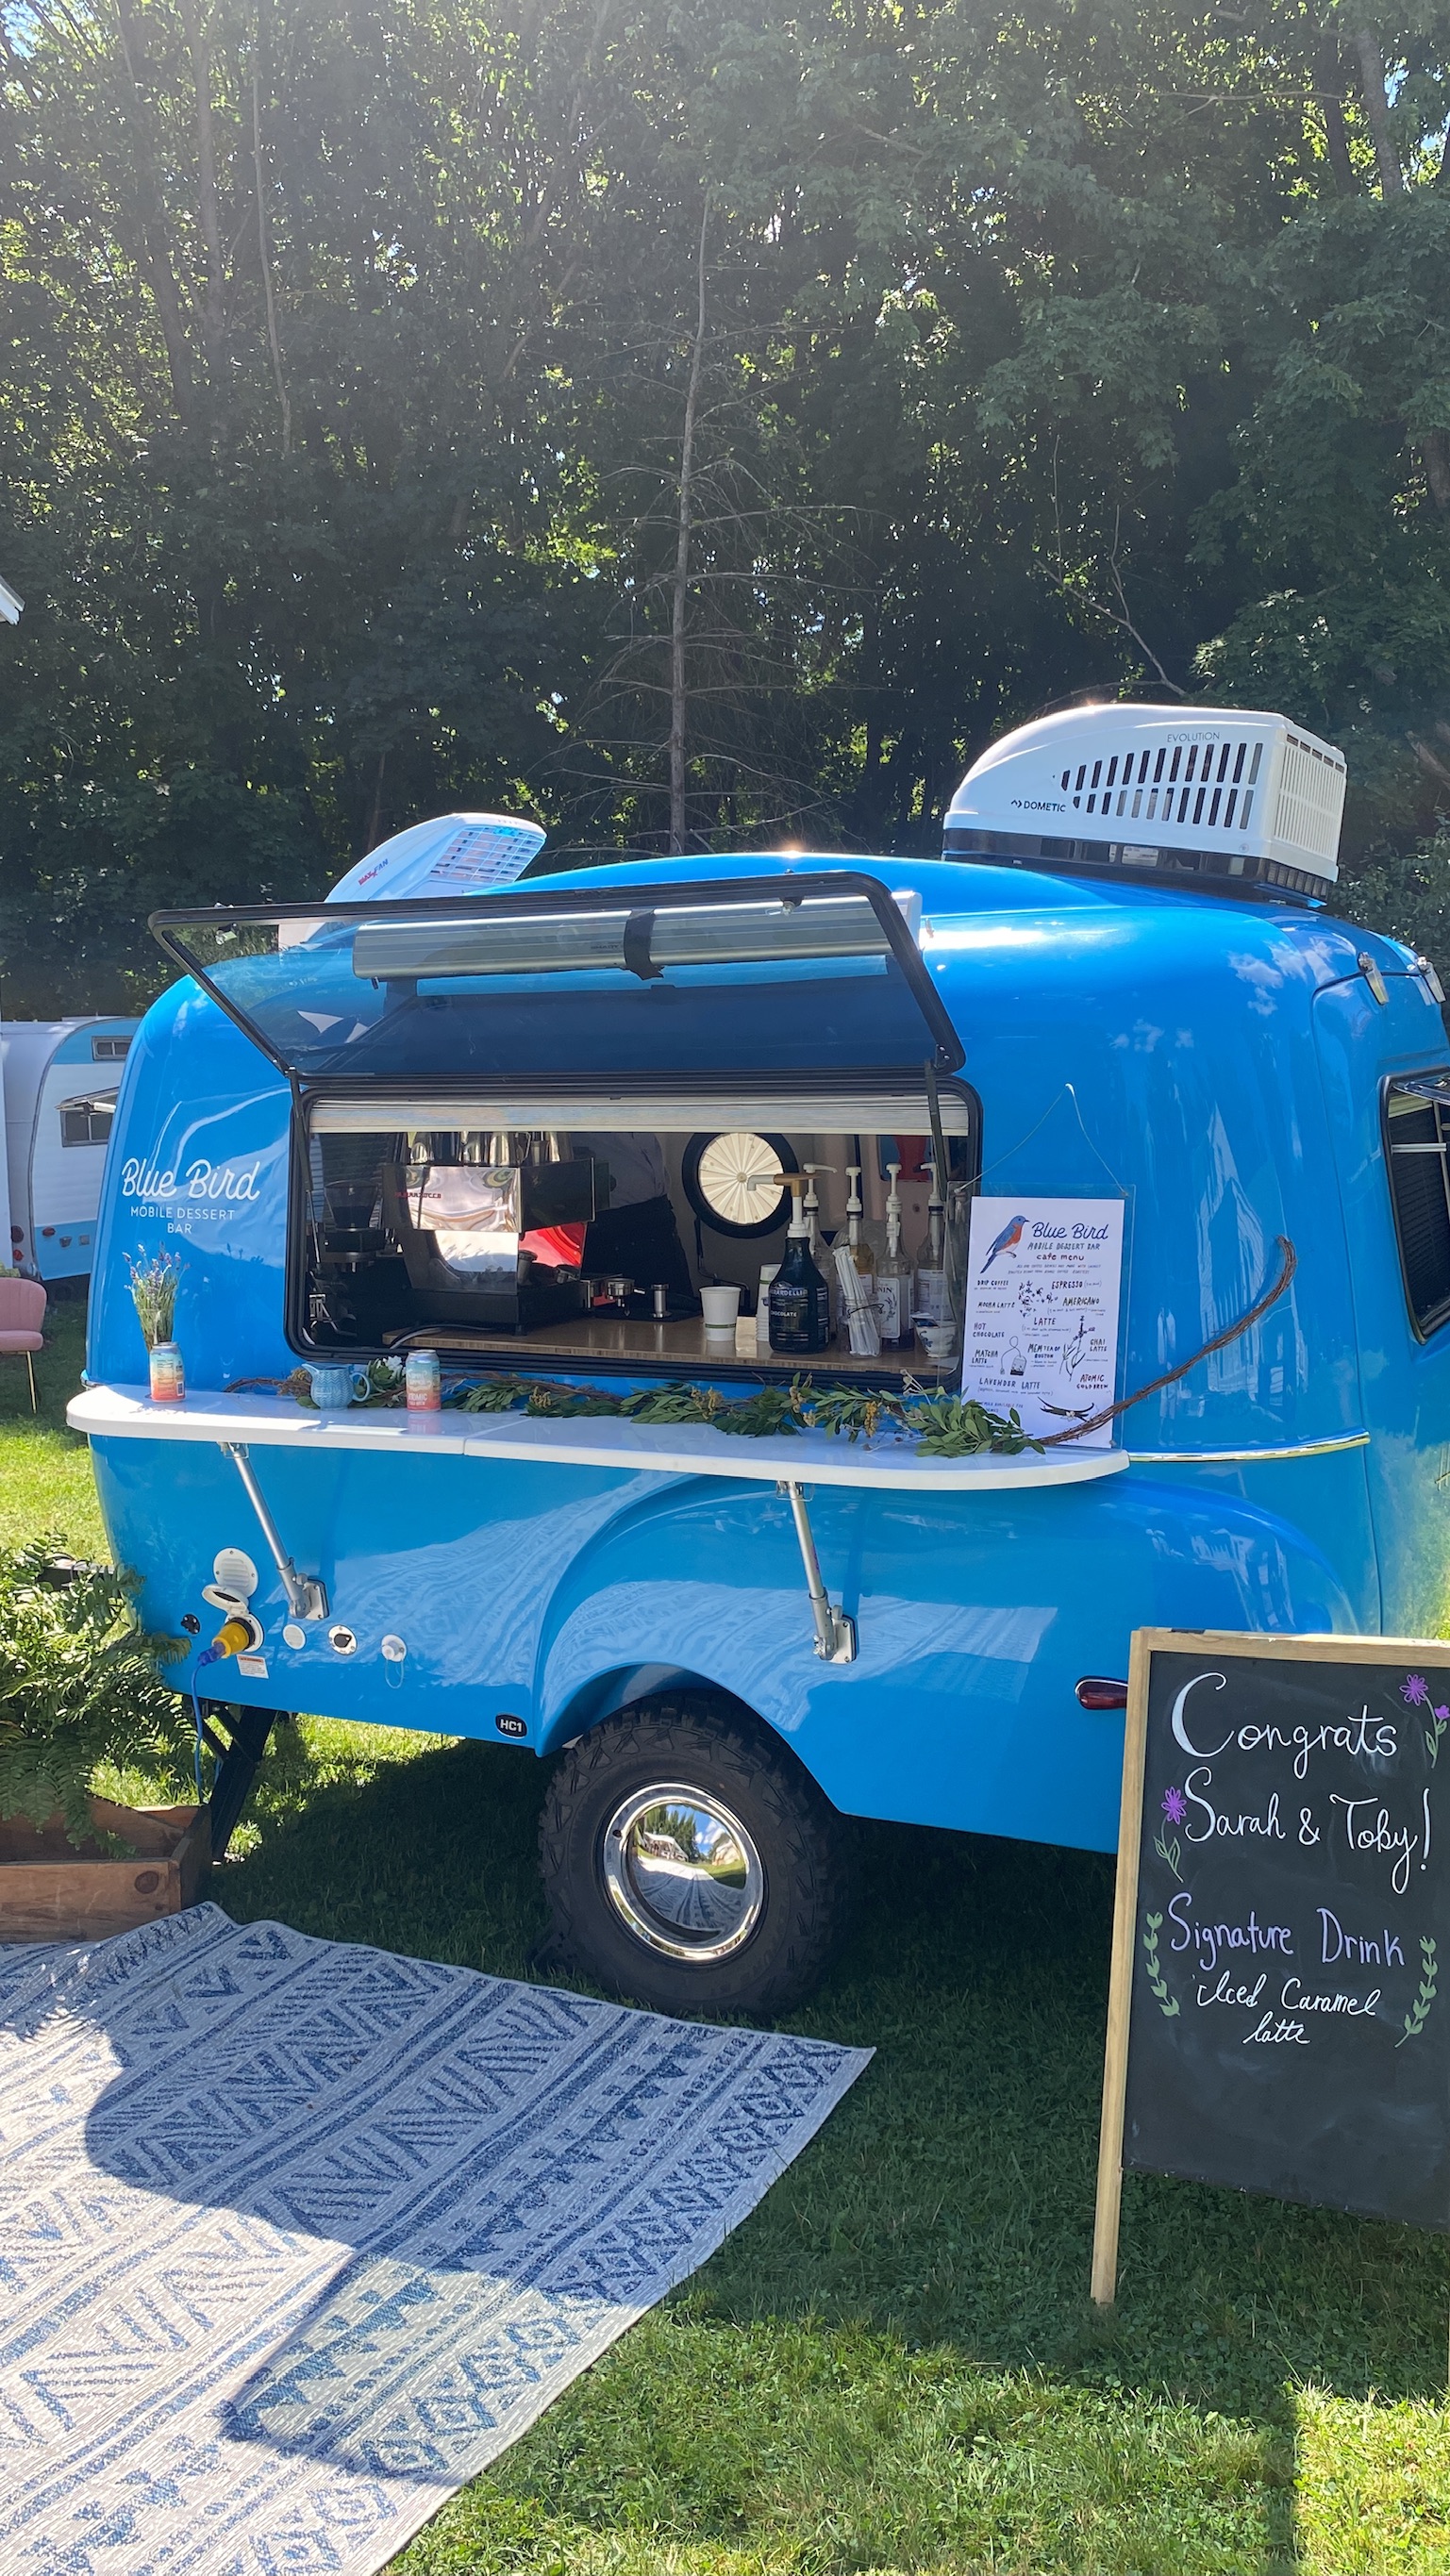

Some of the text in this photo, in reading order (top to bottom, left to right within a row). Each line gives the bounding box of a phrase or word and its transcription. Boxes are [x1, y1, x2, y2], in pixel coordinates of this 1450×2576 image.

[1167, 732, 1220, 742] EVOLUTION
[1024, 800, 1067, 812] DOMETIC
[122, 1157, 260, 1200] Blue Bird
[130, 1205, 235, 1220] MOBILE DESSERT
[167, 1222, 192, 1234] BAR
[1032, 1222, 1109, 1239] Blue Bird
[1027, 1242, 1053, 1251] MOBILE
[1057, 1242, 1085, 1251] DESSERT
[1036, 1253, 1057, 1261] cafe
[1052, 1281, 1083, 1289] ESPRESSO
[1062, 1296, 1100, 1306] AMERICANO
[1033, 1317, 1057, 1326] LATTE
[975, 1349, 999, 1357] MATCHA
[979, 1377, 1016, 1388] LAVENDER
[1022, 1381, 1041, 1389] LATTE
[1080, 1374, 1105, 1383] ATOMIC
[500, 1719, 522, 1732] HC1
[1171, 1671, 1397, 1779] Congrats
[1184, 1766, 1431, 1895] Sarah & Toby!
[1168, 1892, 1405, 1971] Signature Drink
[1280, 1977, 1381, 2017] Caramel
[1242, 2011, 1310, 2045] latte
